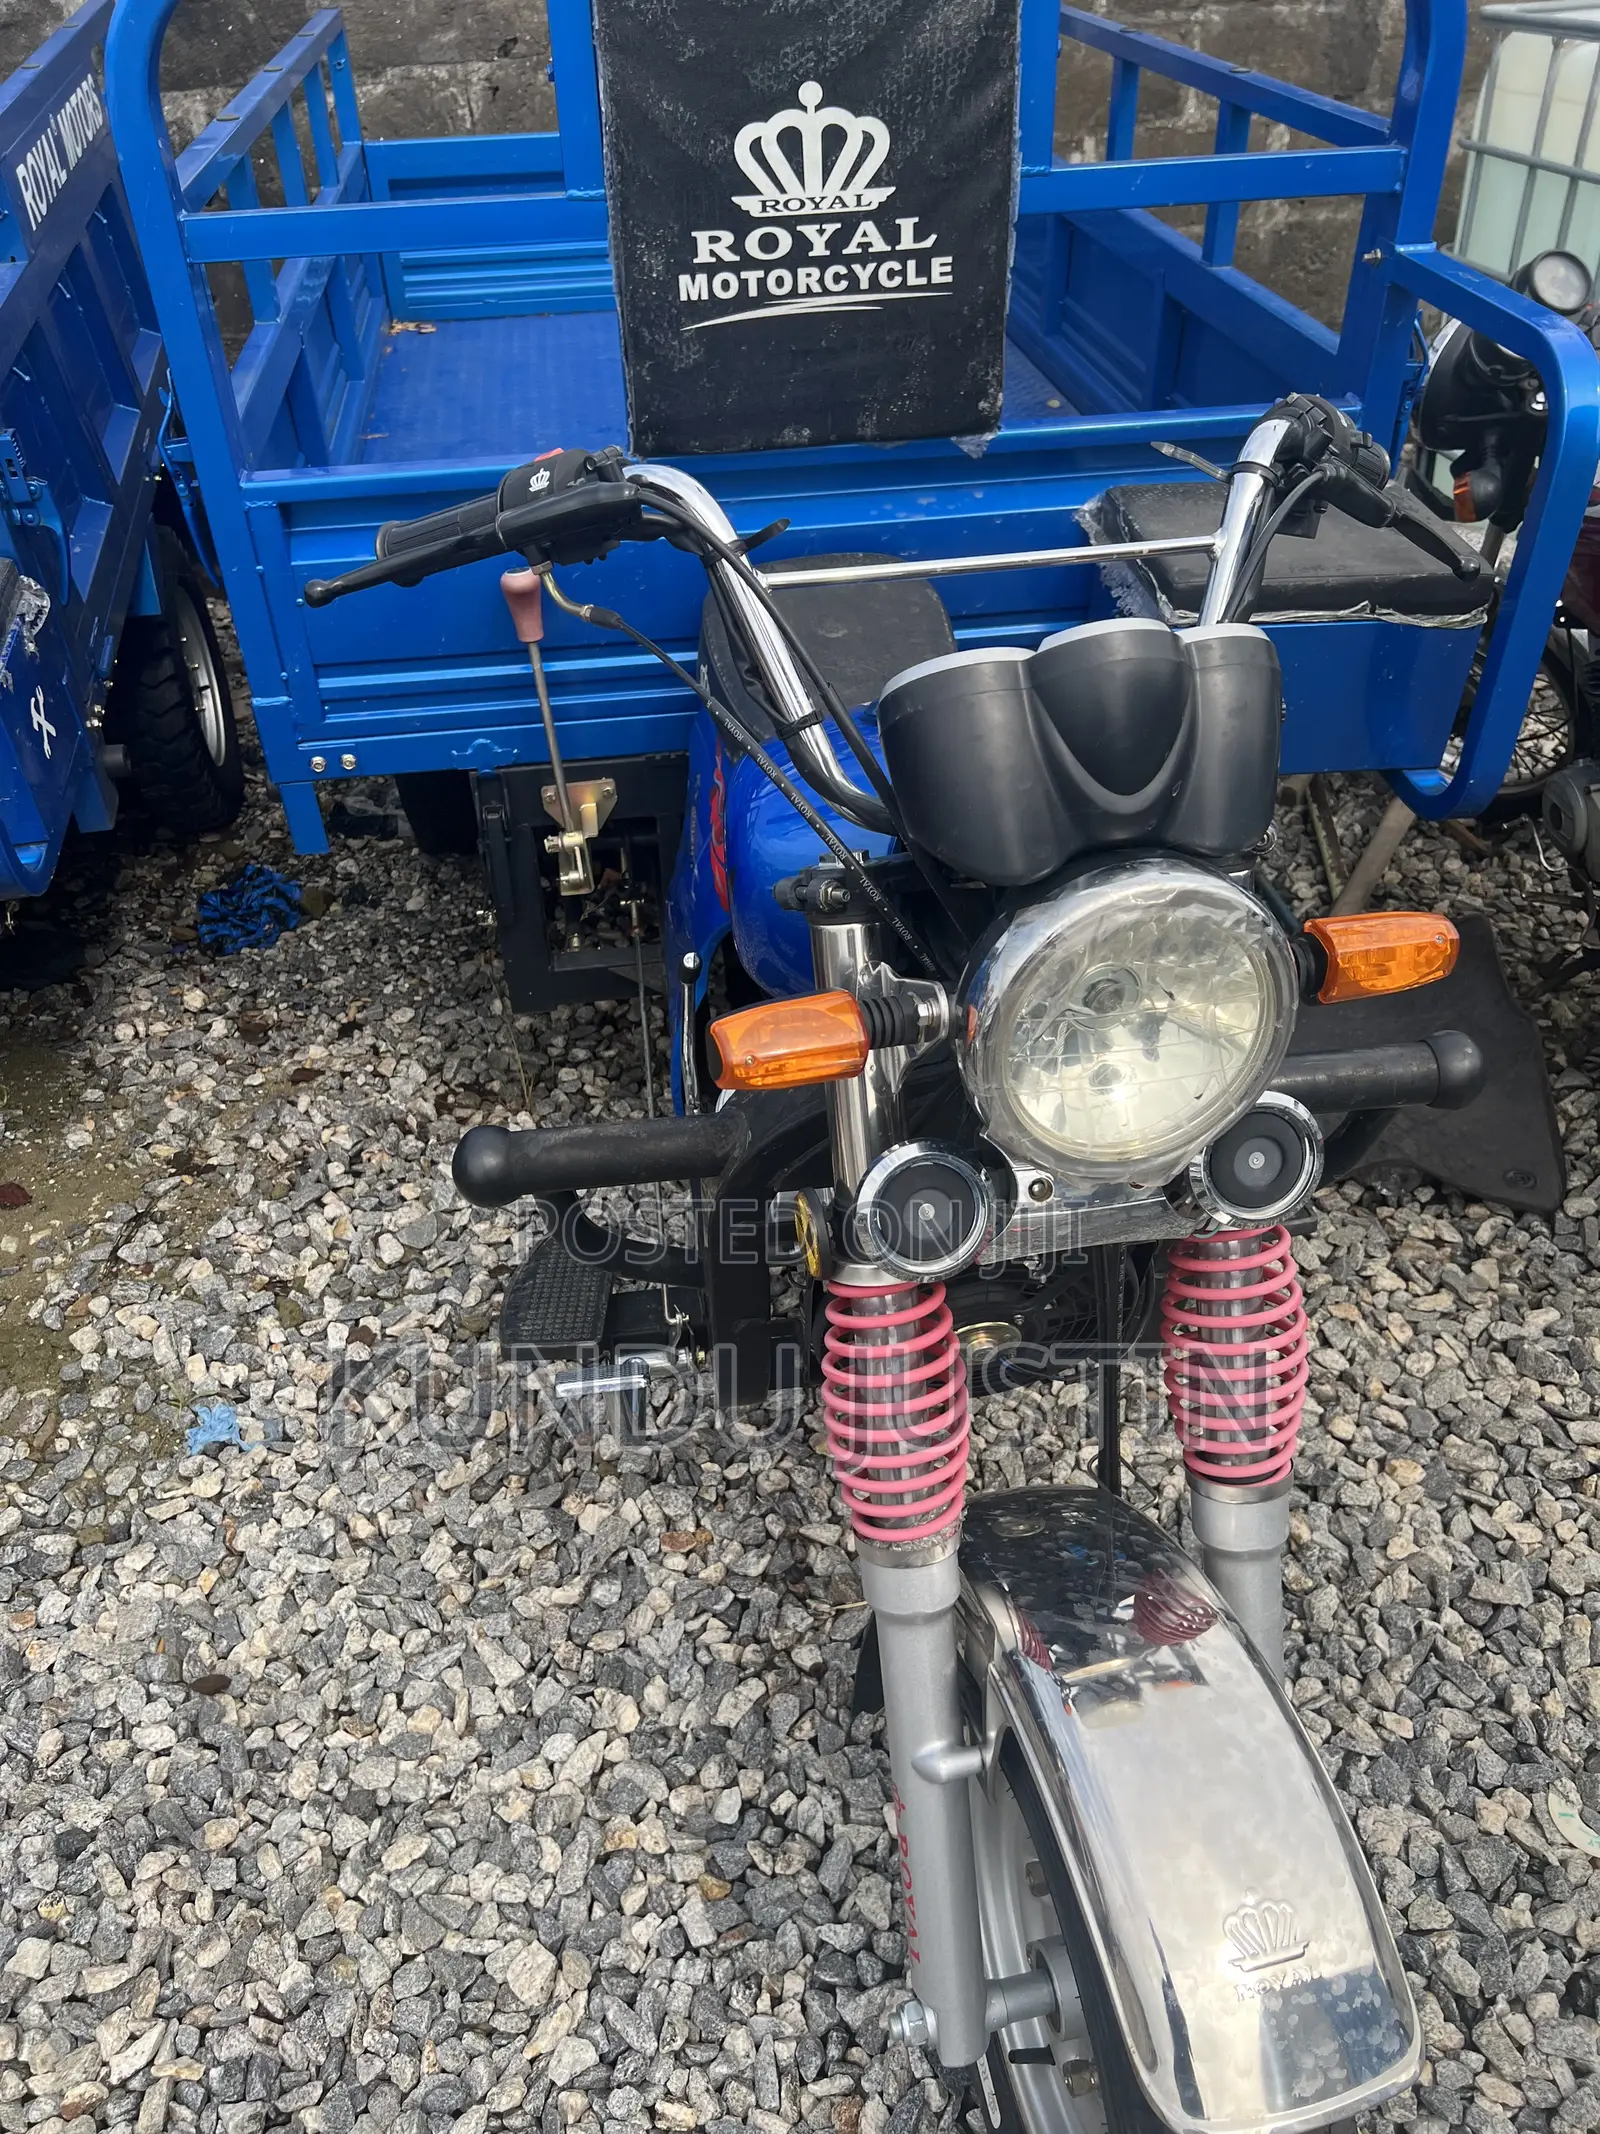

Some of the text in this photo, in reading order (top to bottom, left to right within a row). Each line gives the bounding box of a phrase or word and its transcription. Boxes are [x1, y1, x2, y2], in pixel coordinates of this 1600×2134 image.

[16, 73, 103, 231] ROYAL MOTORS
[758, 193, 874, 214] ROYAL
[691, 216, 938, 264] ROYAL
[677, 256, 954, 302] MOTORCYCLE
[724, 717, 745, 742] ROYAL
[756, 753, 778, 778] ROYAL
[791, 791, 813, 820] ROYAL
[859, 874, 882, 903] ROYAL
[891, 916, 913, 942] ROYAL
[1234, 1965, 1323, 2003] ROYAL
